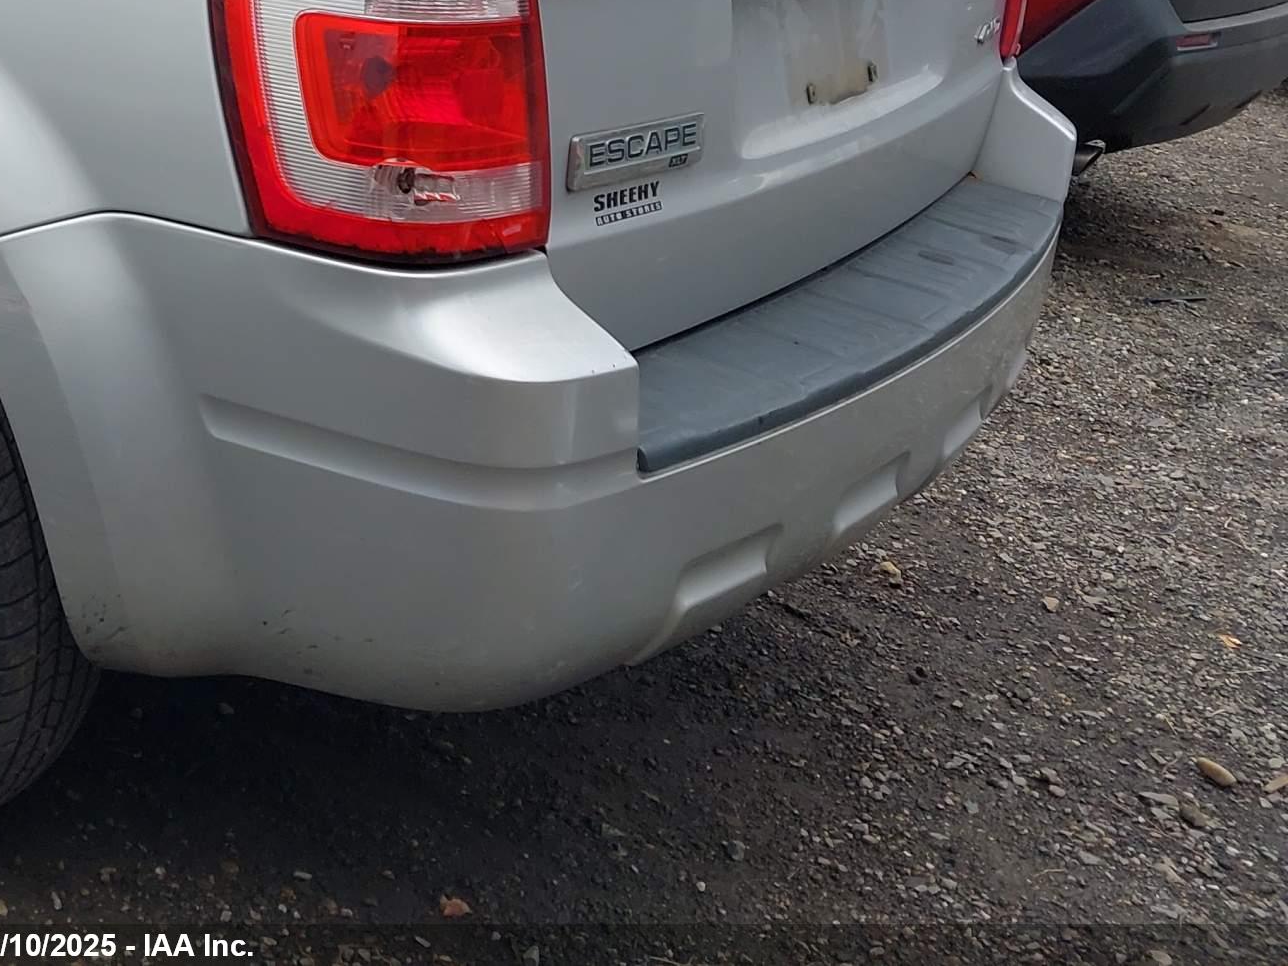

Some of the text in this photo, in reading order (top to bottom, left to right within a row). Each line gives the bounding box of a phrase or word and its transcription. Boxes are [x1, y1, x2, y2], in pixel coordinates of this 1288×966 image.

[587, 121, 697, 167] ESCAPE
[593, 180, 660, 212] SHEEHY
[596, 201, 662, 226] AUTO STORES
